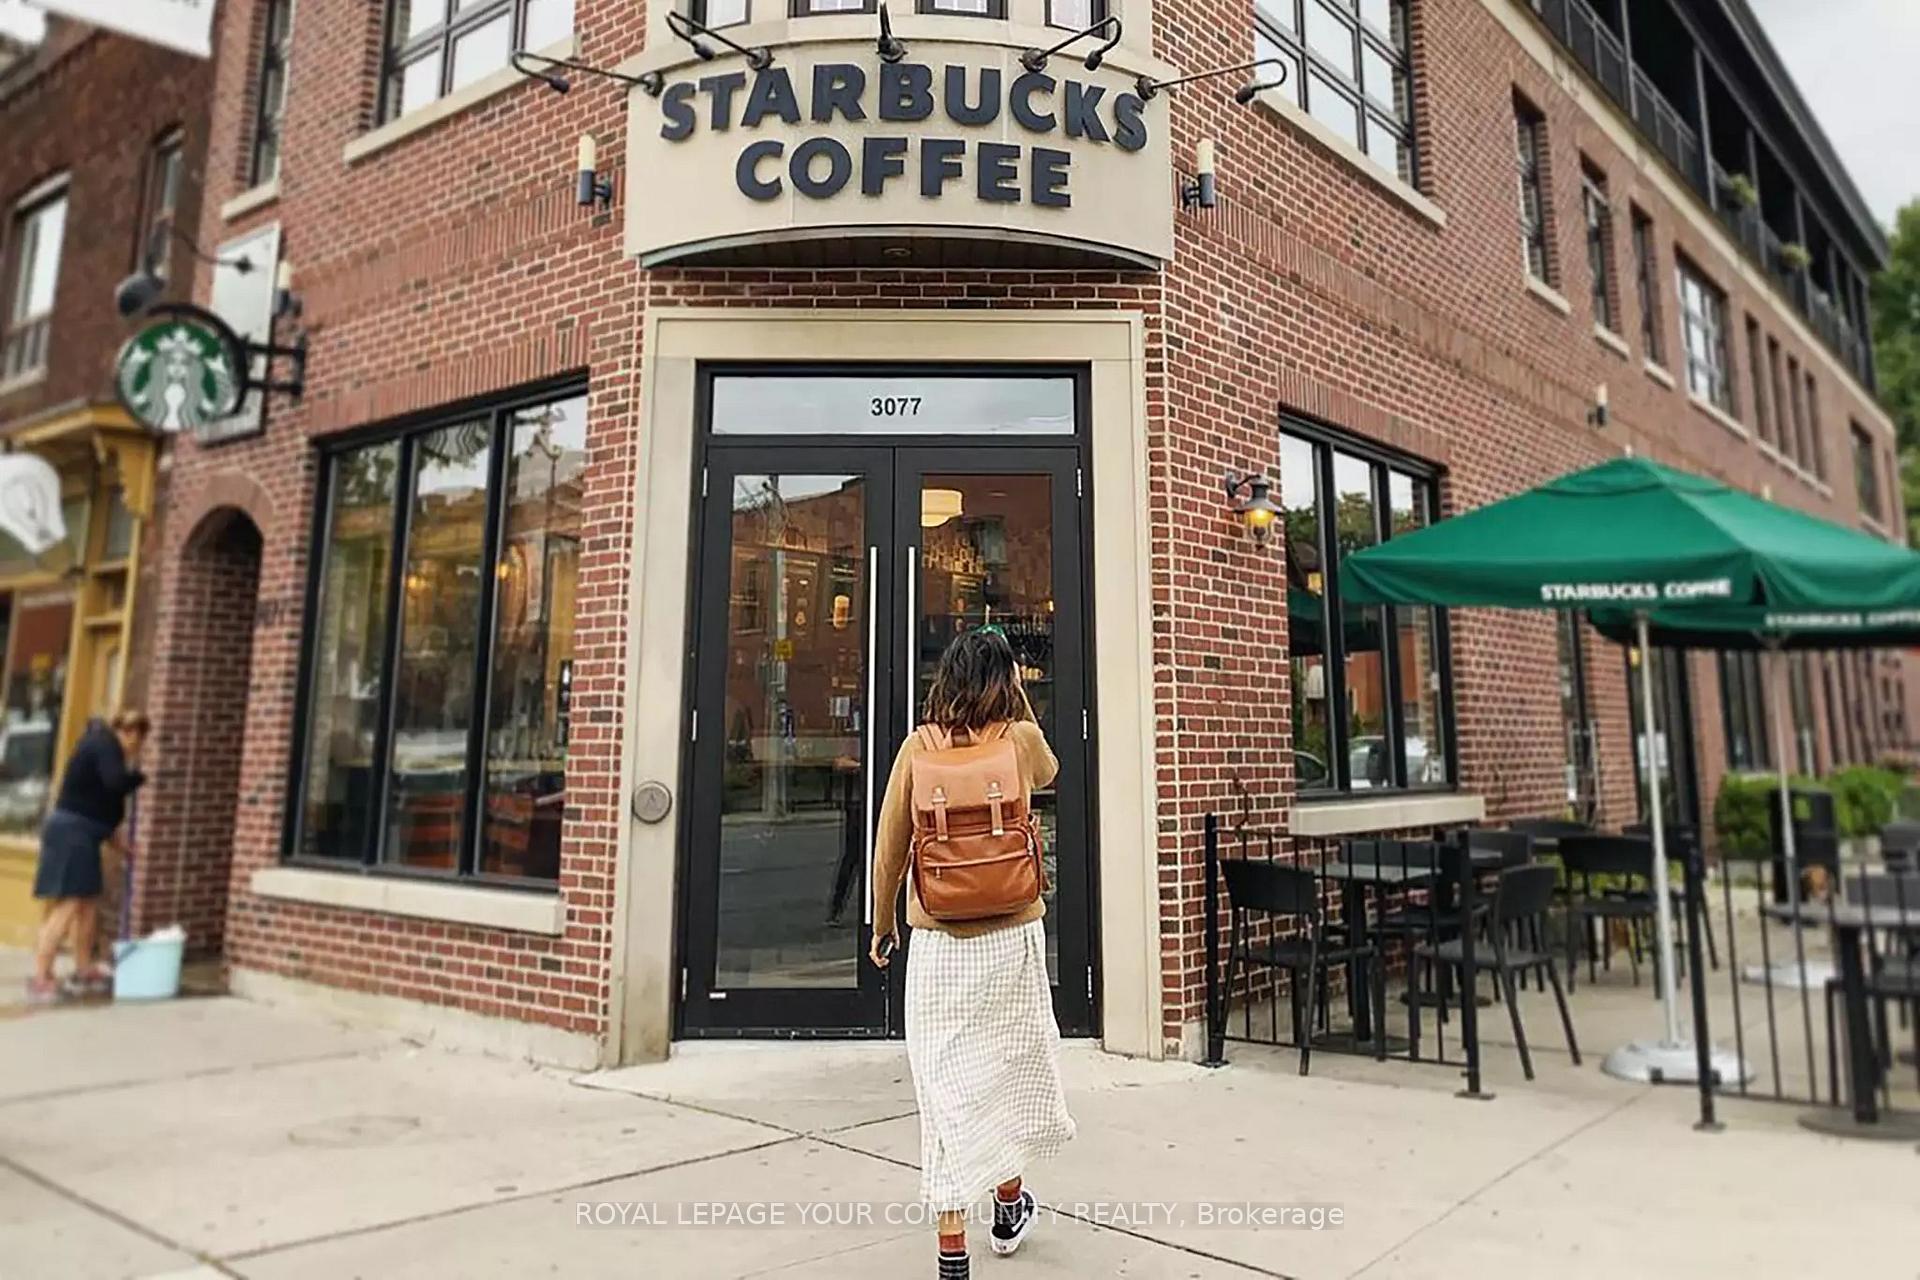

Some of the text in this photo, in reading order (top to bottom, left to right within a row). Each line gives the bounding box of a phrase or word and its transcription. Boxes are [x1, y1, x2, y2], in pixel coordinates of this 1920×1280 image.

[660, 63, 1148, 152] STARBUCKS
[735, 136, 1072, 208] COFFEE
[871, 397, 922, 417] 3077
[1540, 583, 1659, 601] STARBUCKS
